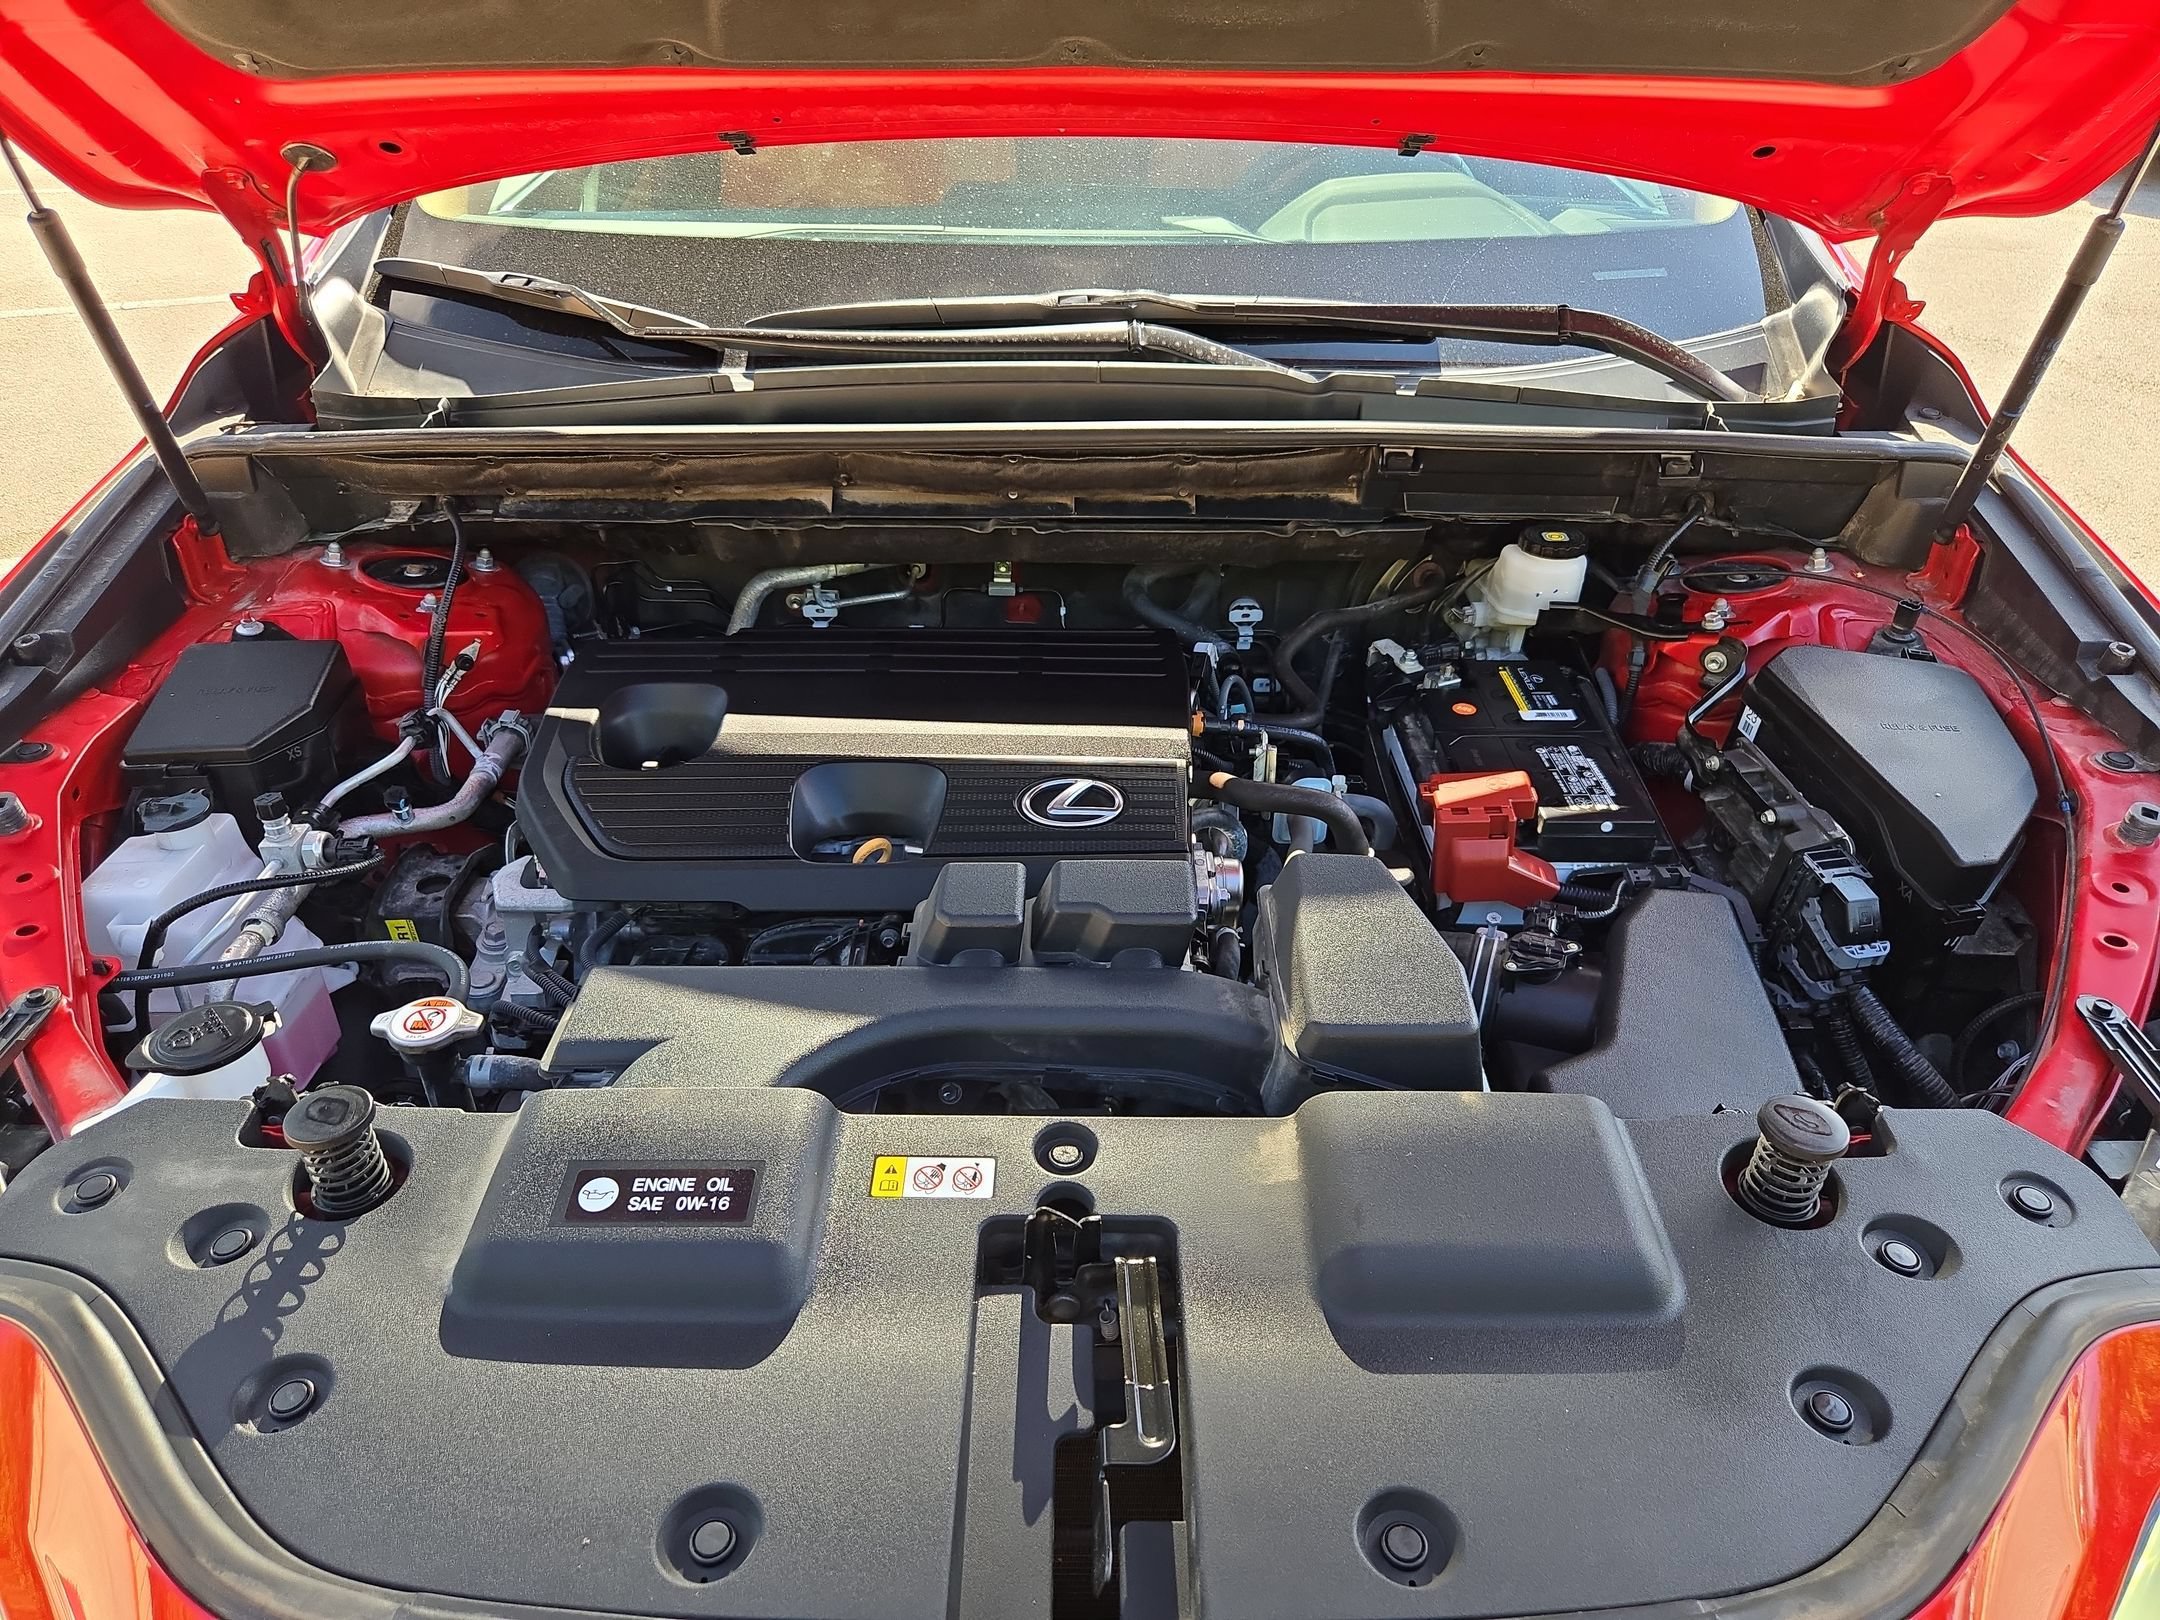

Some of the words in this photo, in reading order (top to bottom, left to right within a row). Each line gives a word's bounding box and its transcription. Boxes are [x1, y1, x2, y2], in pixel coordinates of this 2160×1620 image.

[1517, 667, 1535, 690] LEXUS
[1928, 724, 1960, 732] FUSE
[632, 1177, 696, 1192] ENGINE
[706, 1177, 734, 1192] OIL
[627, 1196, 665, 1212] SAE
[675, 1196, 731, 1211] 0W-16
